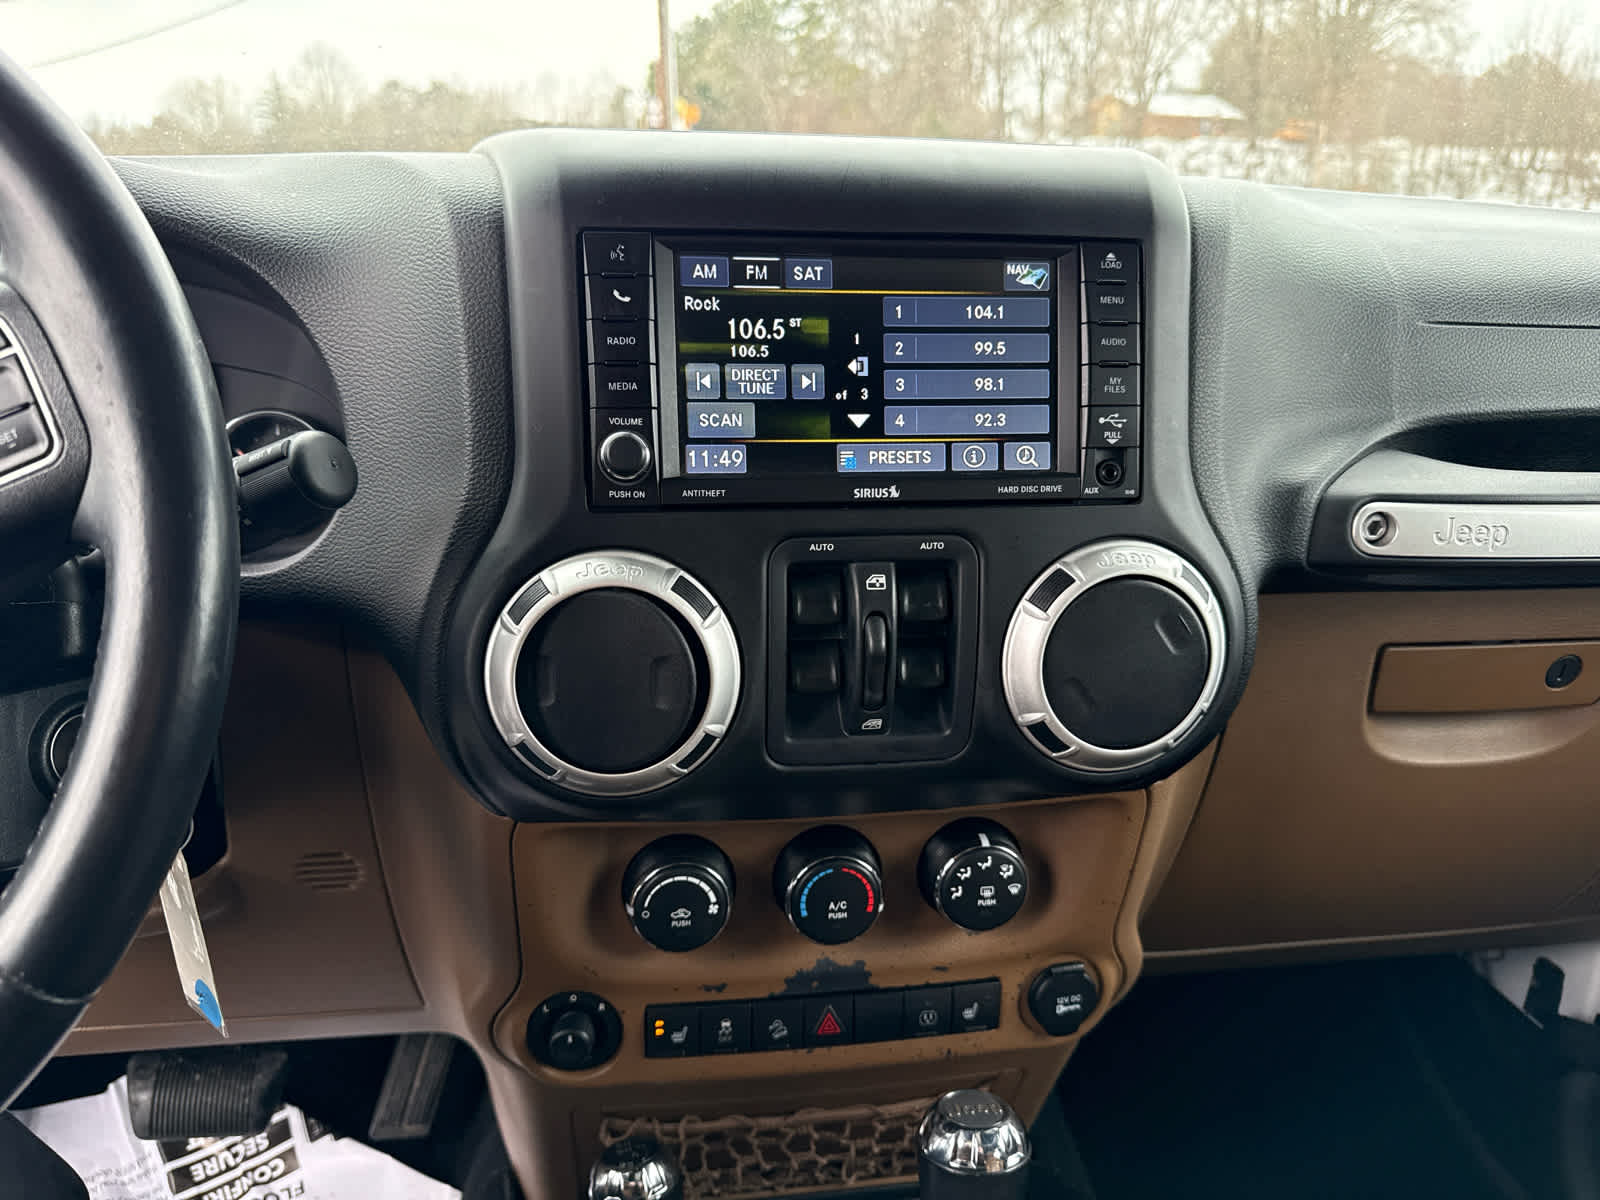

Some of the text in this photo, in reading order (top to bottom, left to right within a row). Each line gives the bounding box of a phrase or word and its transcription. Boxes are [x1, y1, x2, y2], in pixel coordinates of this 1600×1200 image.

[692, 264, 717, 279] AM
[1006, 264, 1030, 275] NAV
[1100, 261, 1122, 269] LOAD
[746, 264, 768, 280] FM
[793, 266, 823, 281] SAT
[684, 296, 720, 311] Rock
[1100, 296, 1124, 305] MENU
[895, 305, 902, 319] 1
[965, 305, 1004, 319] 104.1
[728, 317, 802, 340] 106.5 ST
[607, 336, 636, 345] RADIO
[854, 333, 860, 345] 1
[1100, 338, 1127, 346] AUDIO
[730, 345, 769, 358] 106.5
[895, 341, 904, 356] 2
[974, 341, 1006, 356] 99.5
[731, 368, 780, 382] DIRECT
[1109, 377, 1122, 385] MY
[608, 382, 638, 391] MEDIA
[738, 382, 775, 395] TUNE
[895, 378, 905, 392] 3
[974, 378, 1004, 392] 98.1
[1104, 385, 1126, 394] FILES
[835, 388, 869, 400] of 3
[608, 417, 644, 426] VOLUME
[699, 413, 743, 428] SCAN
[895, 414, 905, 427] 4
[974, 413, 1006, 427] 92.3
[1103, 431, 1122, 439] PULL
[688, 450, 744, 468] 11:49
[869, 450, 932, 465] PRESETS
[608, 490, 646, 499] PUSH ON
[682, 489, 726, 497] ANTITHEFT
[854, 487, 889, 498] SIRIUS
[998, 484, 1063, 494] HARD DISC DRIVE
[1084, 487, 1099, 495] AUX
[1432, 515, 1511, 552] Jeep
[809, 543, 834, 552] AUTO
[920, 542, 945, 550] AUTO
[1096, 552, 1156, 568] Jeep
[575, 562, 644, 583] Jeep
[828, 901, 848, 911] A/C
[977, 898, 996, 906] PUSH
[828, 912, 848, 920] PUSH
[671, 919, 691, 928] PUSH
[189, 1132, 270, 1182] SECURE
[202, 1158, 286, 1200] CONFIR
